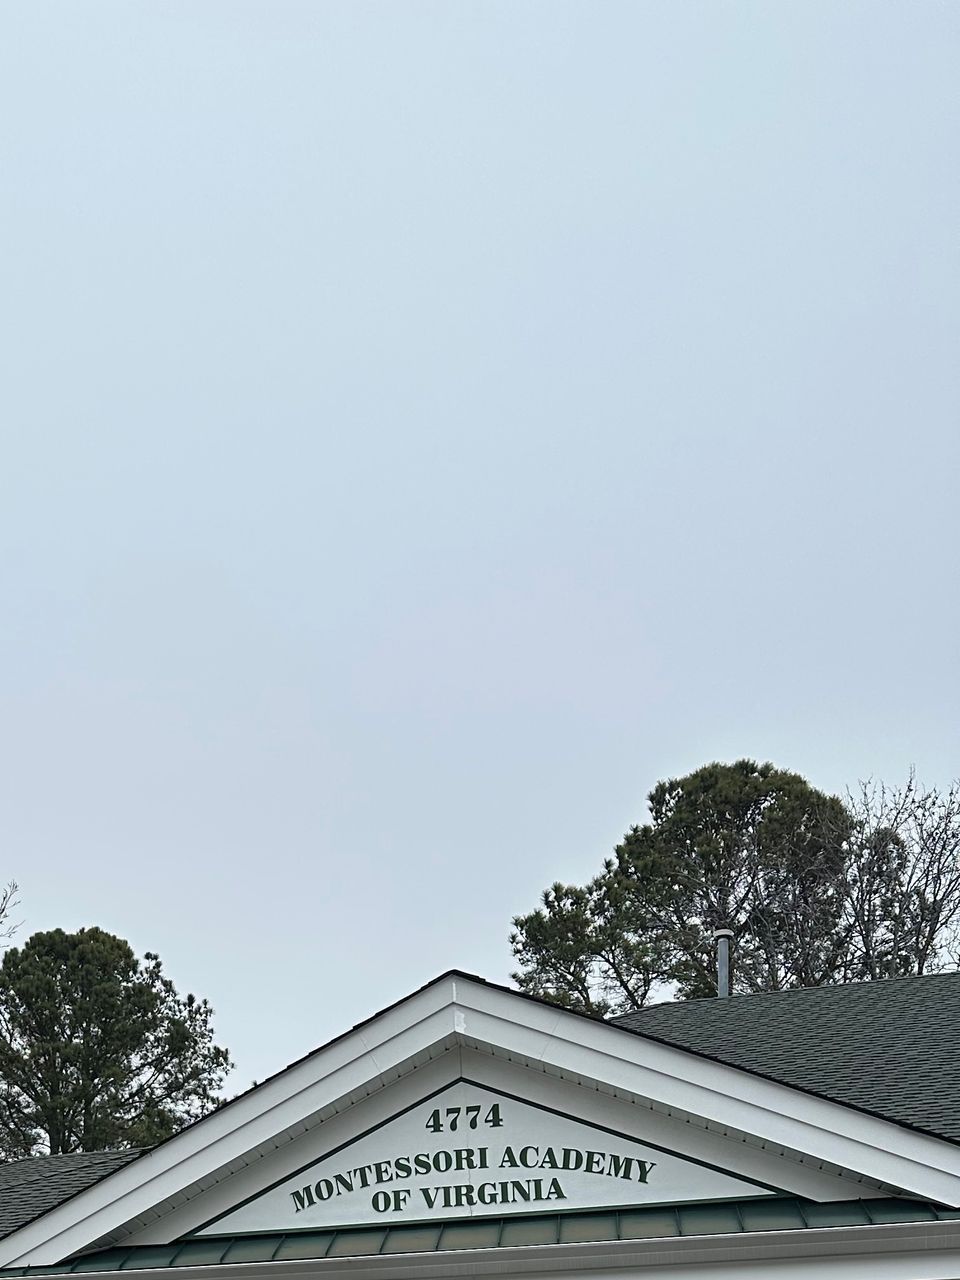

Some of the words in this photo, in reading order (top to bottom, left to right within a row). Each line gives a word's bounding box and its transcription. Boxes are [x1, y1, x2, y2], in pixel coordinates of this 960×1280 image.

[425, 1103, 503, 1133] 4774
[290, 1146, 489, 1213] MONTESSORI
[498, 1145, 657, 1185] ACADEMY
[371, 1189, 411, 1213] OF
[419, 1177, 567, 1210] VIRGINIA
